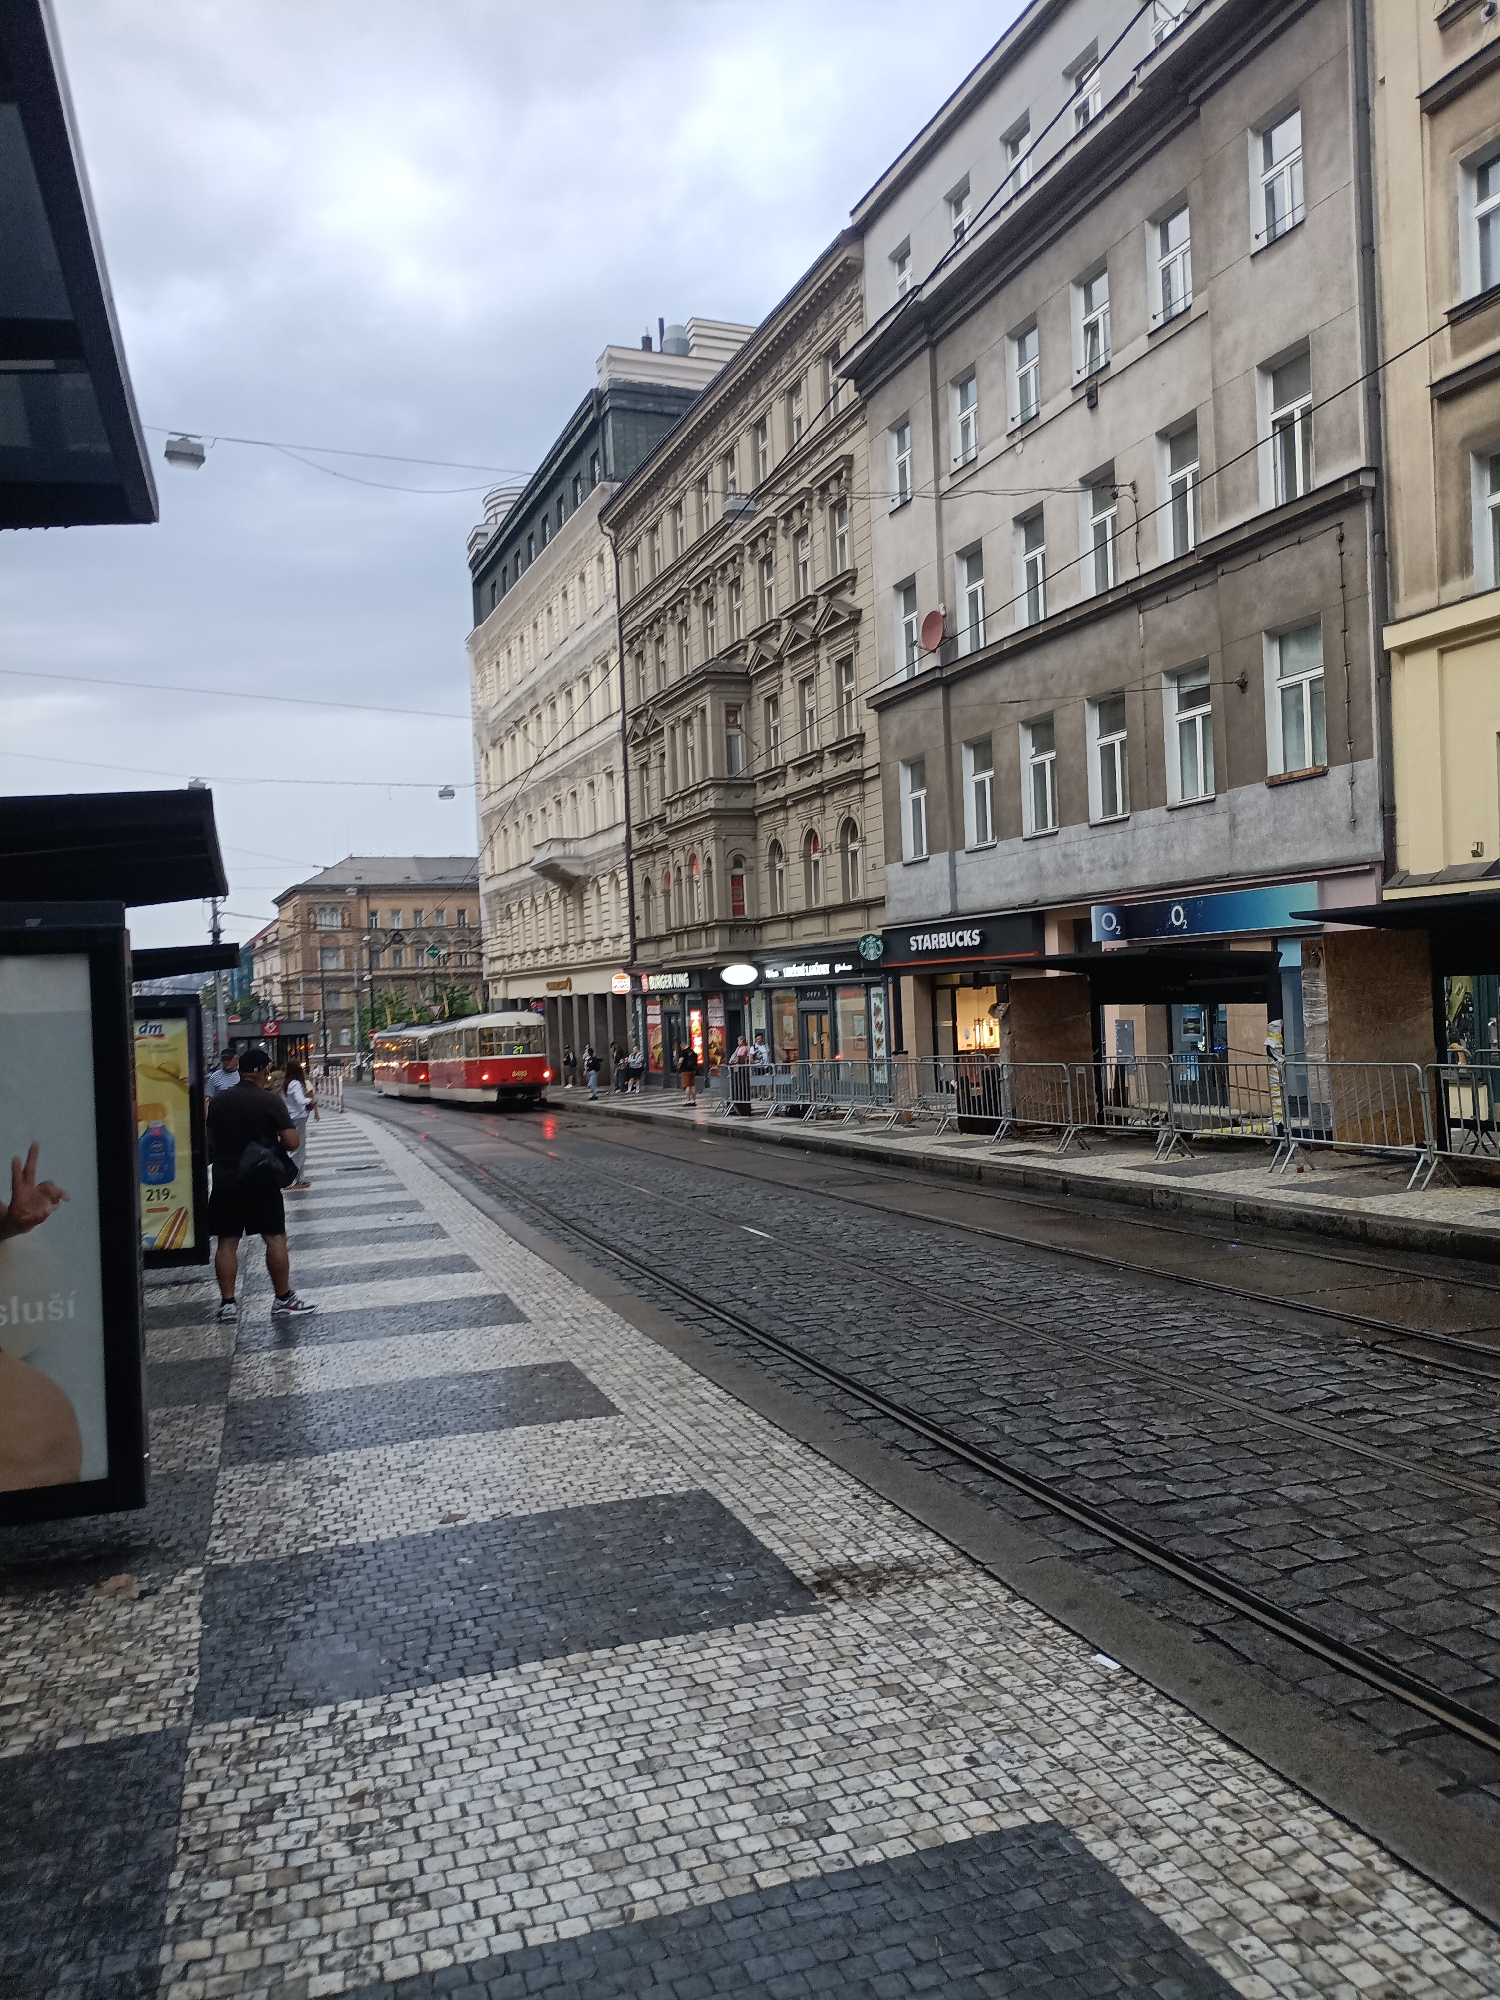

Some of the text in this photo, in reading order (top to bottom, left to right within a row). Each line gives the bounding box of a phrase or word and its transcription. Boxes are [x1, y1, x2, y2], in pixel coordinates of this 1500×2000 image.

[909, 928, 981, 952] STARBUCKS
[649, 972, 689, 990] BURGER KING
[139, 1020, 163, 1034] dm
[145, 1187, 171, 1202] 219
